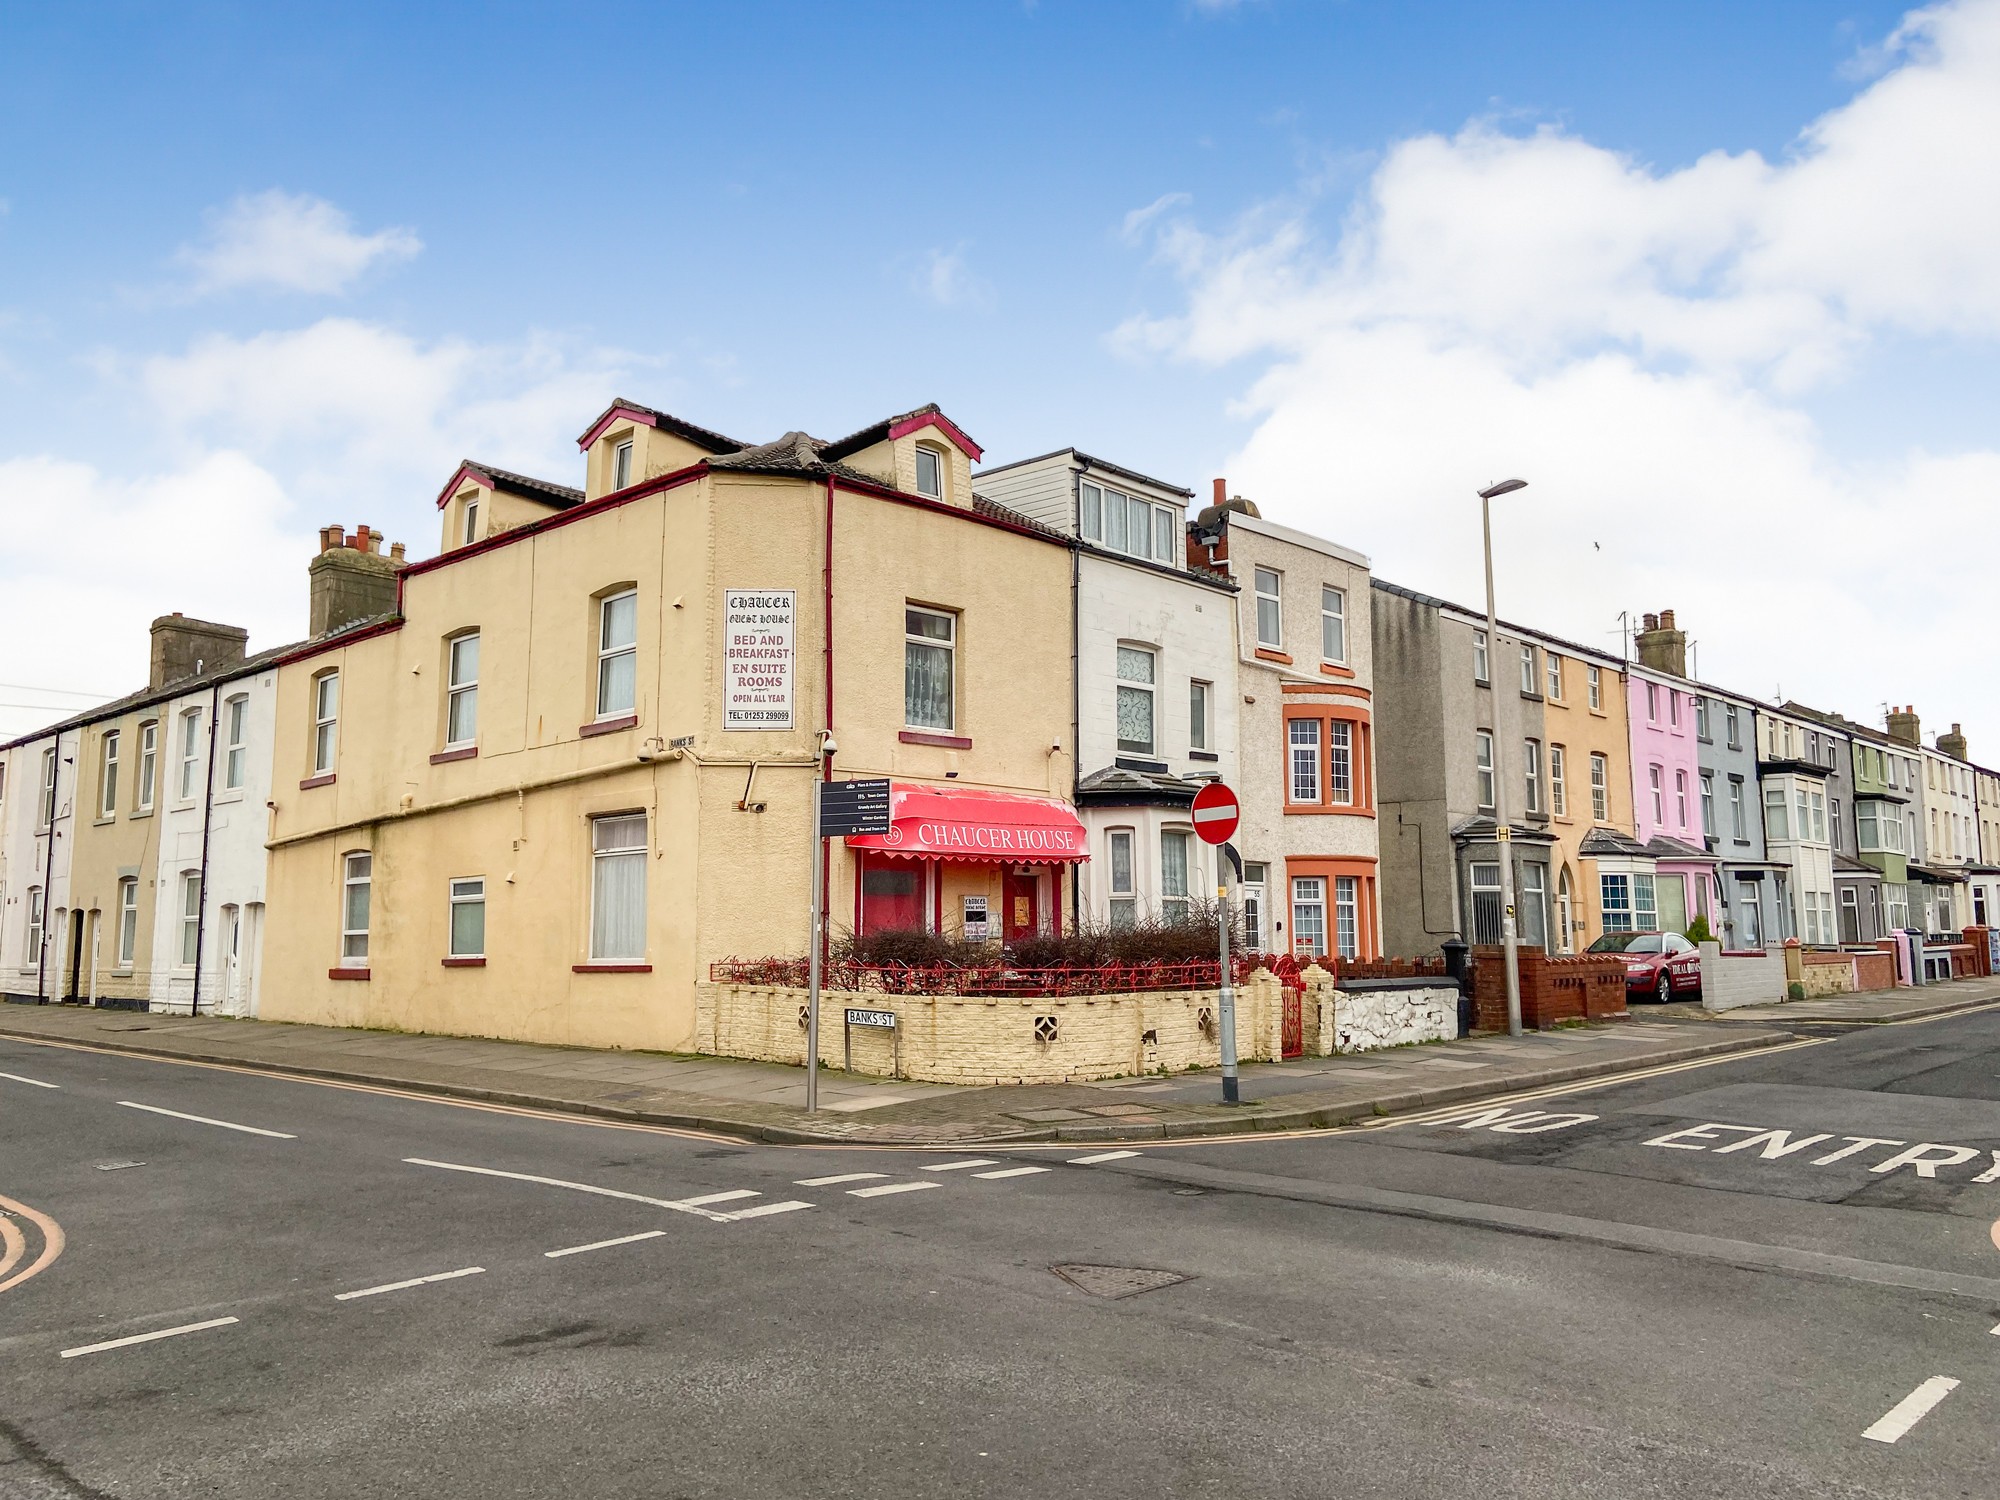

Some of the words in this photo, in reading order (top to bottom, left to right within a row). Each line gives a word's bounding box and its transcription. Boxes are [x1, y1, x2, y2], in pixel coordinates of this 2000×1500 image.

[730, 597, 790, 610] CHAUCER
[729, 614, 757, 624] GUEST
[759, 614, 790, 625] HOUSE
[734, 635, 756, 645] BED
[760, 635, 784, 645] AND
[729, 648, 789, 658] BREAKFAST
[732, 663, 748, 673] EN
[751, 663, 786, 673] SUITE
[737, 677, 782, 687] ROOMS
[732, 694, 752, 702] OPEN
[754, 694, 766, 702] ALL
[768, 694, 785, 702] YEAR
[728, 711, 743, 719] TEL:
[744, 711, 764, 719] 01253
[918, 823, 1015, 849] CHAUCER
[1016, 829, 1076, 850] HOUSE
[850, 1011, 878, 1024] BANKS
[882, 1014, 893, 1026] ST
[1420, 1107, 1599, 1134] NO
